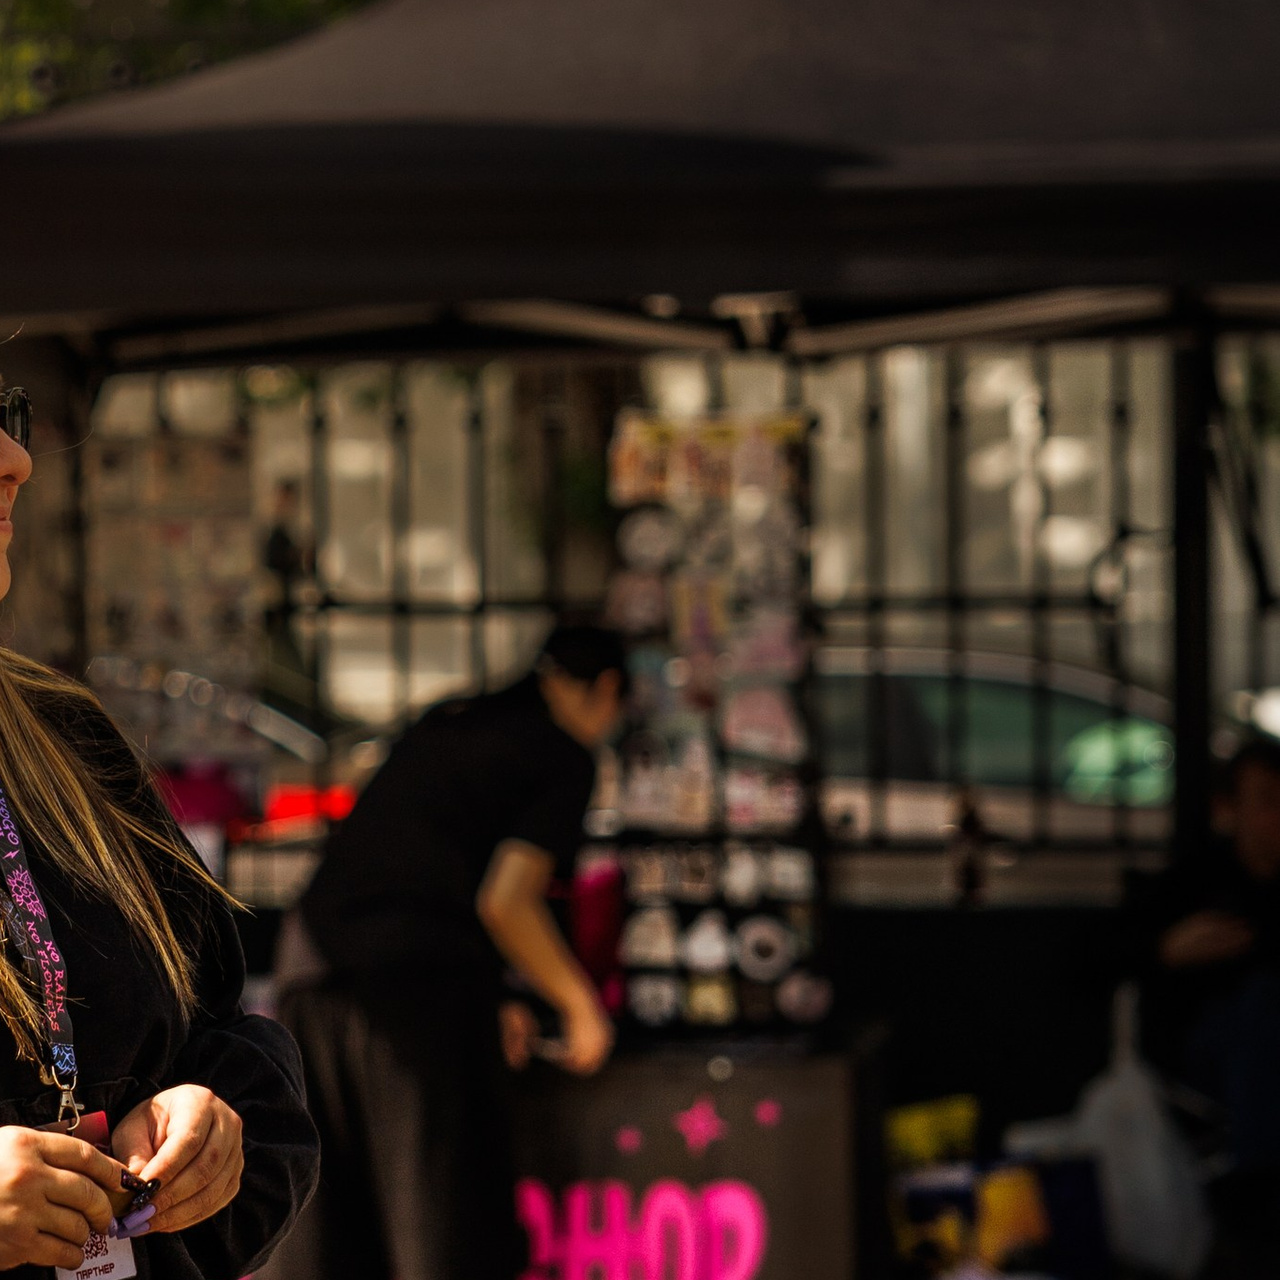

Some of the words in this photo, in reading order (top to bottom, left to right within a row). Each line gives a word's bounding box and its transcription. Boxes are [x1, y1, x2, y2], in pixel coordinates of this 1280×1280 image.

[26, 920, 41, 944] NO
[36, 949, 61, 1032] FLOWERS
[44, 939, 61, 963] NO
[54, 969, 66, 1014] RAIN
